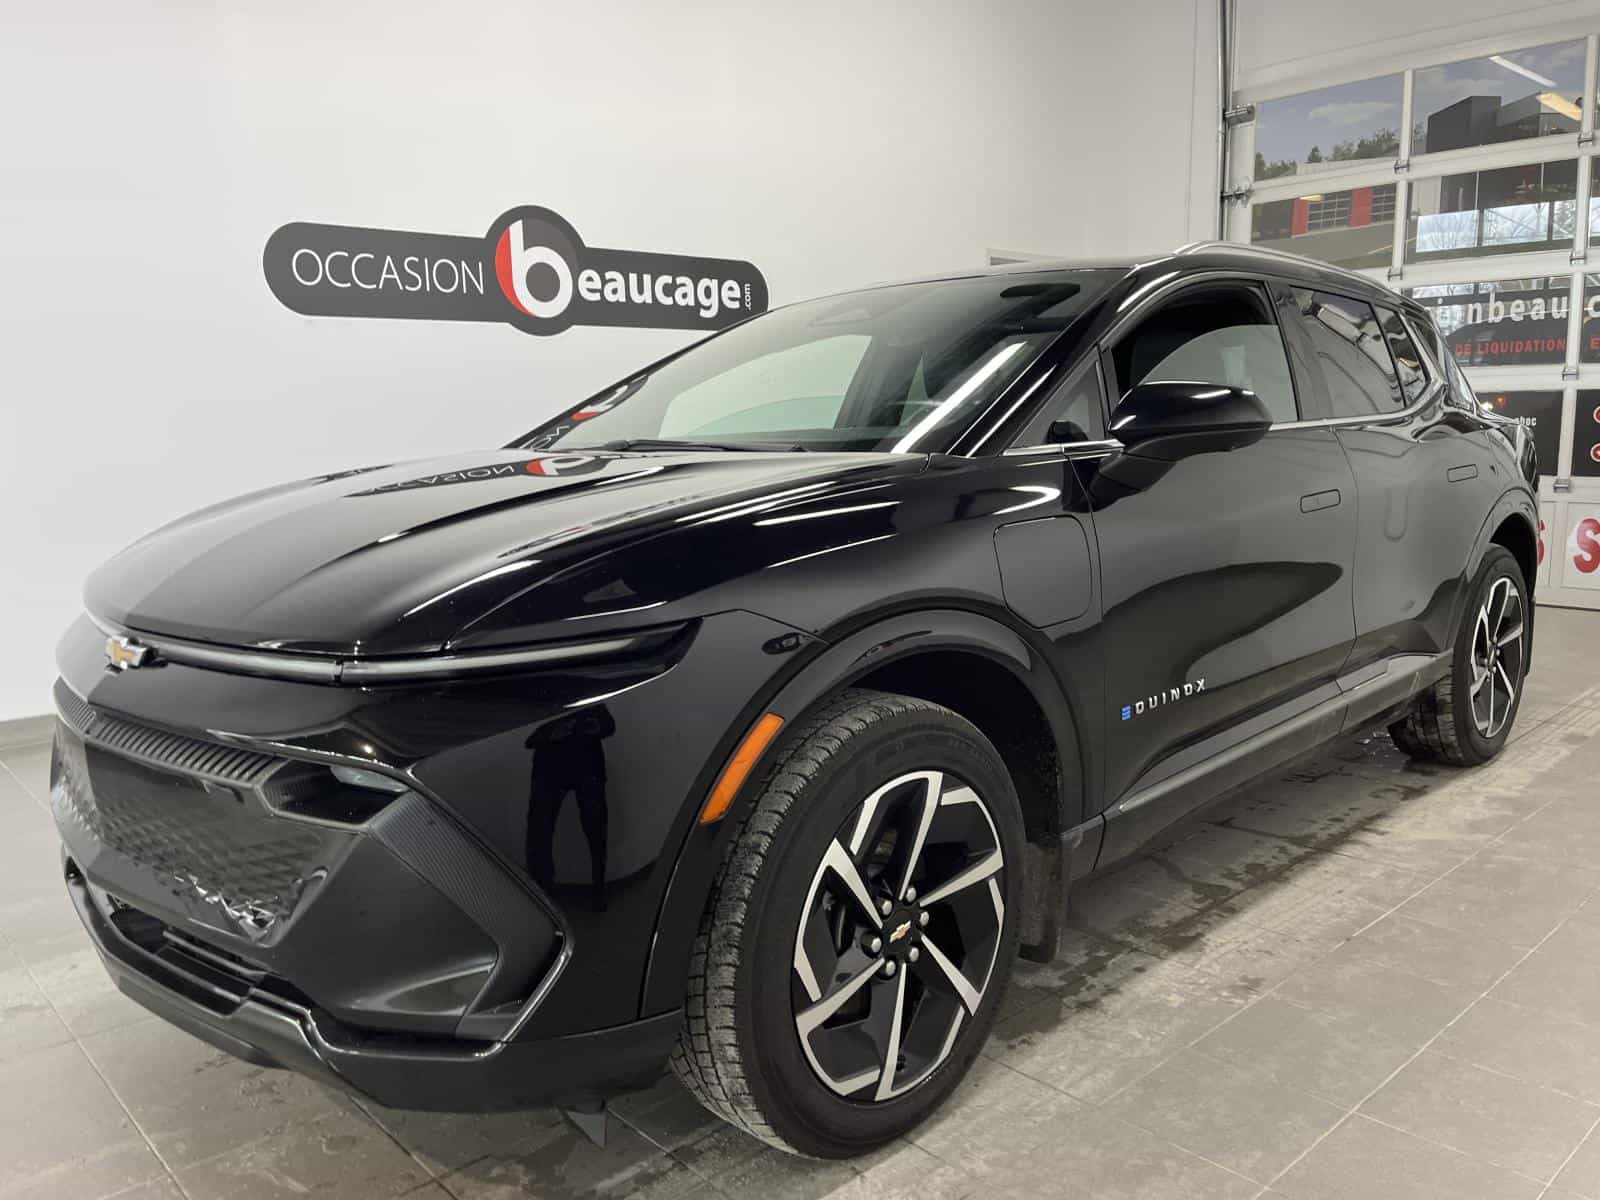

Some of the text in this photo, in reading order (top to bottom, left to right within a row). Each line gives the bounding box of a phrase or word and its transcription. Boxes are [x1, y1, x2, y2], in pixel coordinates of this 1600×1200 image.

[292, 248, 484, 295] OCCASION
[1456, 342, 1473, 357] DE
[1477, 337, 1567, 355] LIQUIDATION
[1121, 678, 1206, 721] EQUINOX
